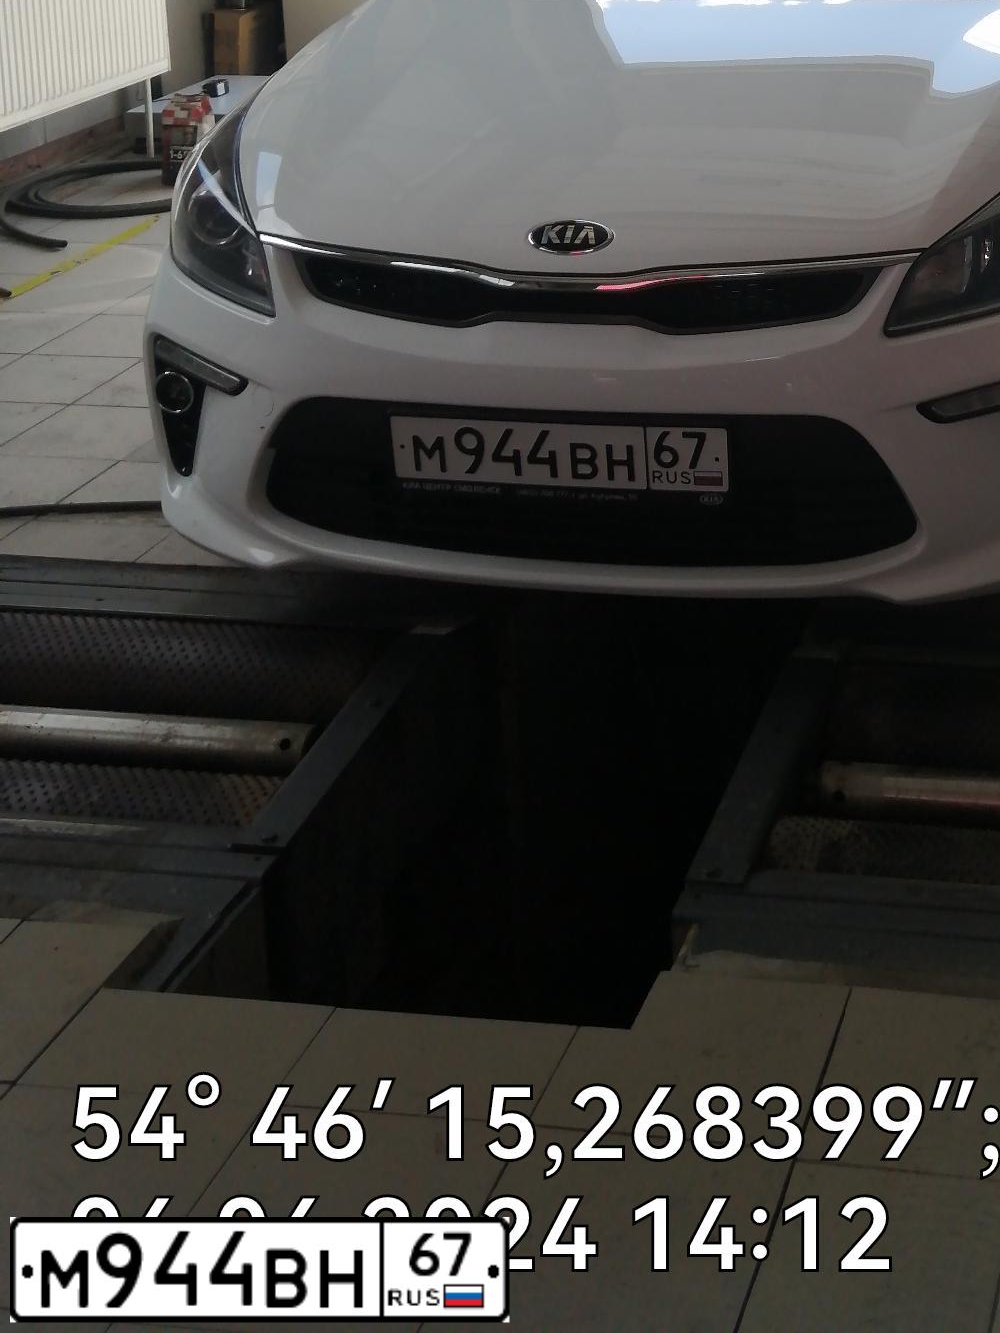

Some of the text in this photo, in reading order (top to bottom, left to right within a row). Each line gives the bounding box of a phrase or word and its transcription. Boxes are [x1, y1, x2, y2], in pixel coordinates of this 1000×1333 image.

[540, 225, 596, 245] KIA
[654, 430, 707, 471] 67
[652, 470, 691, 485] RUS
